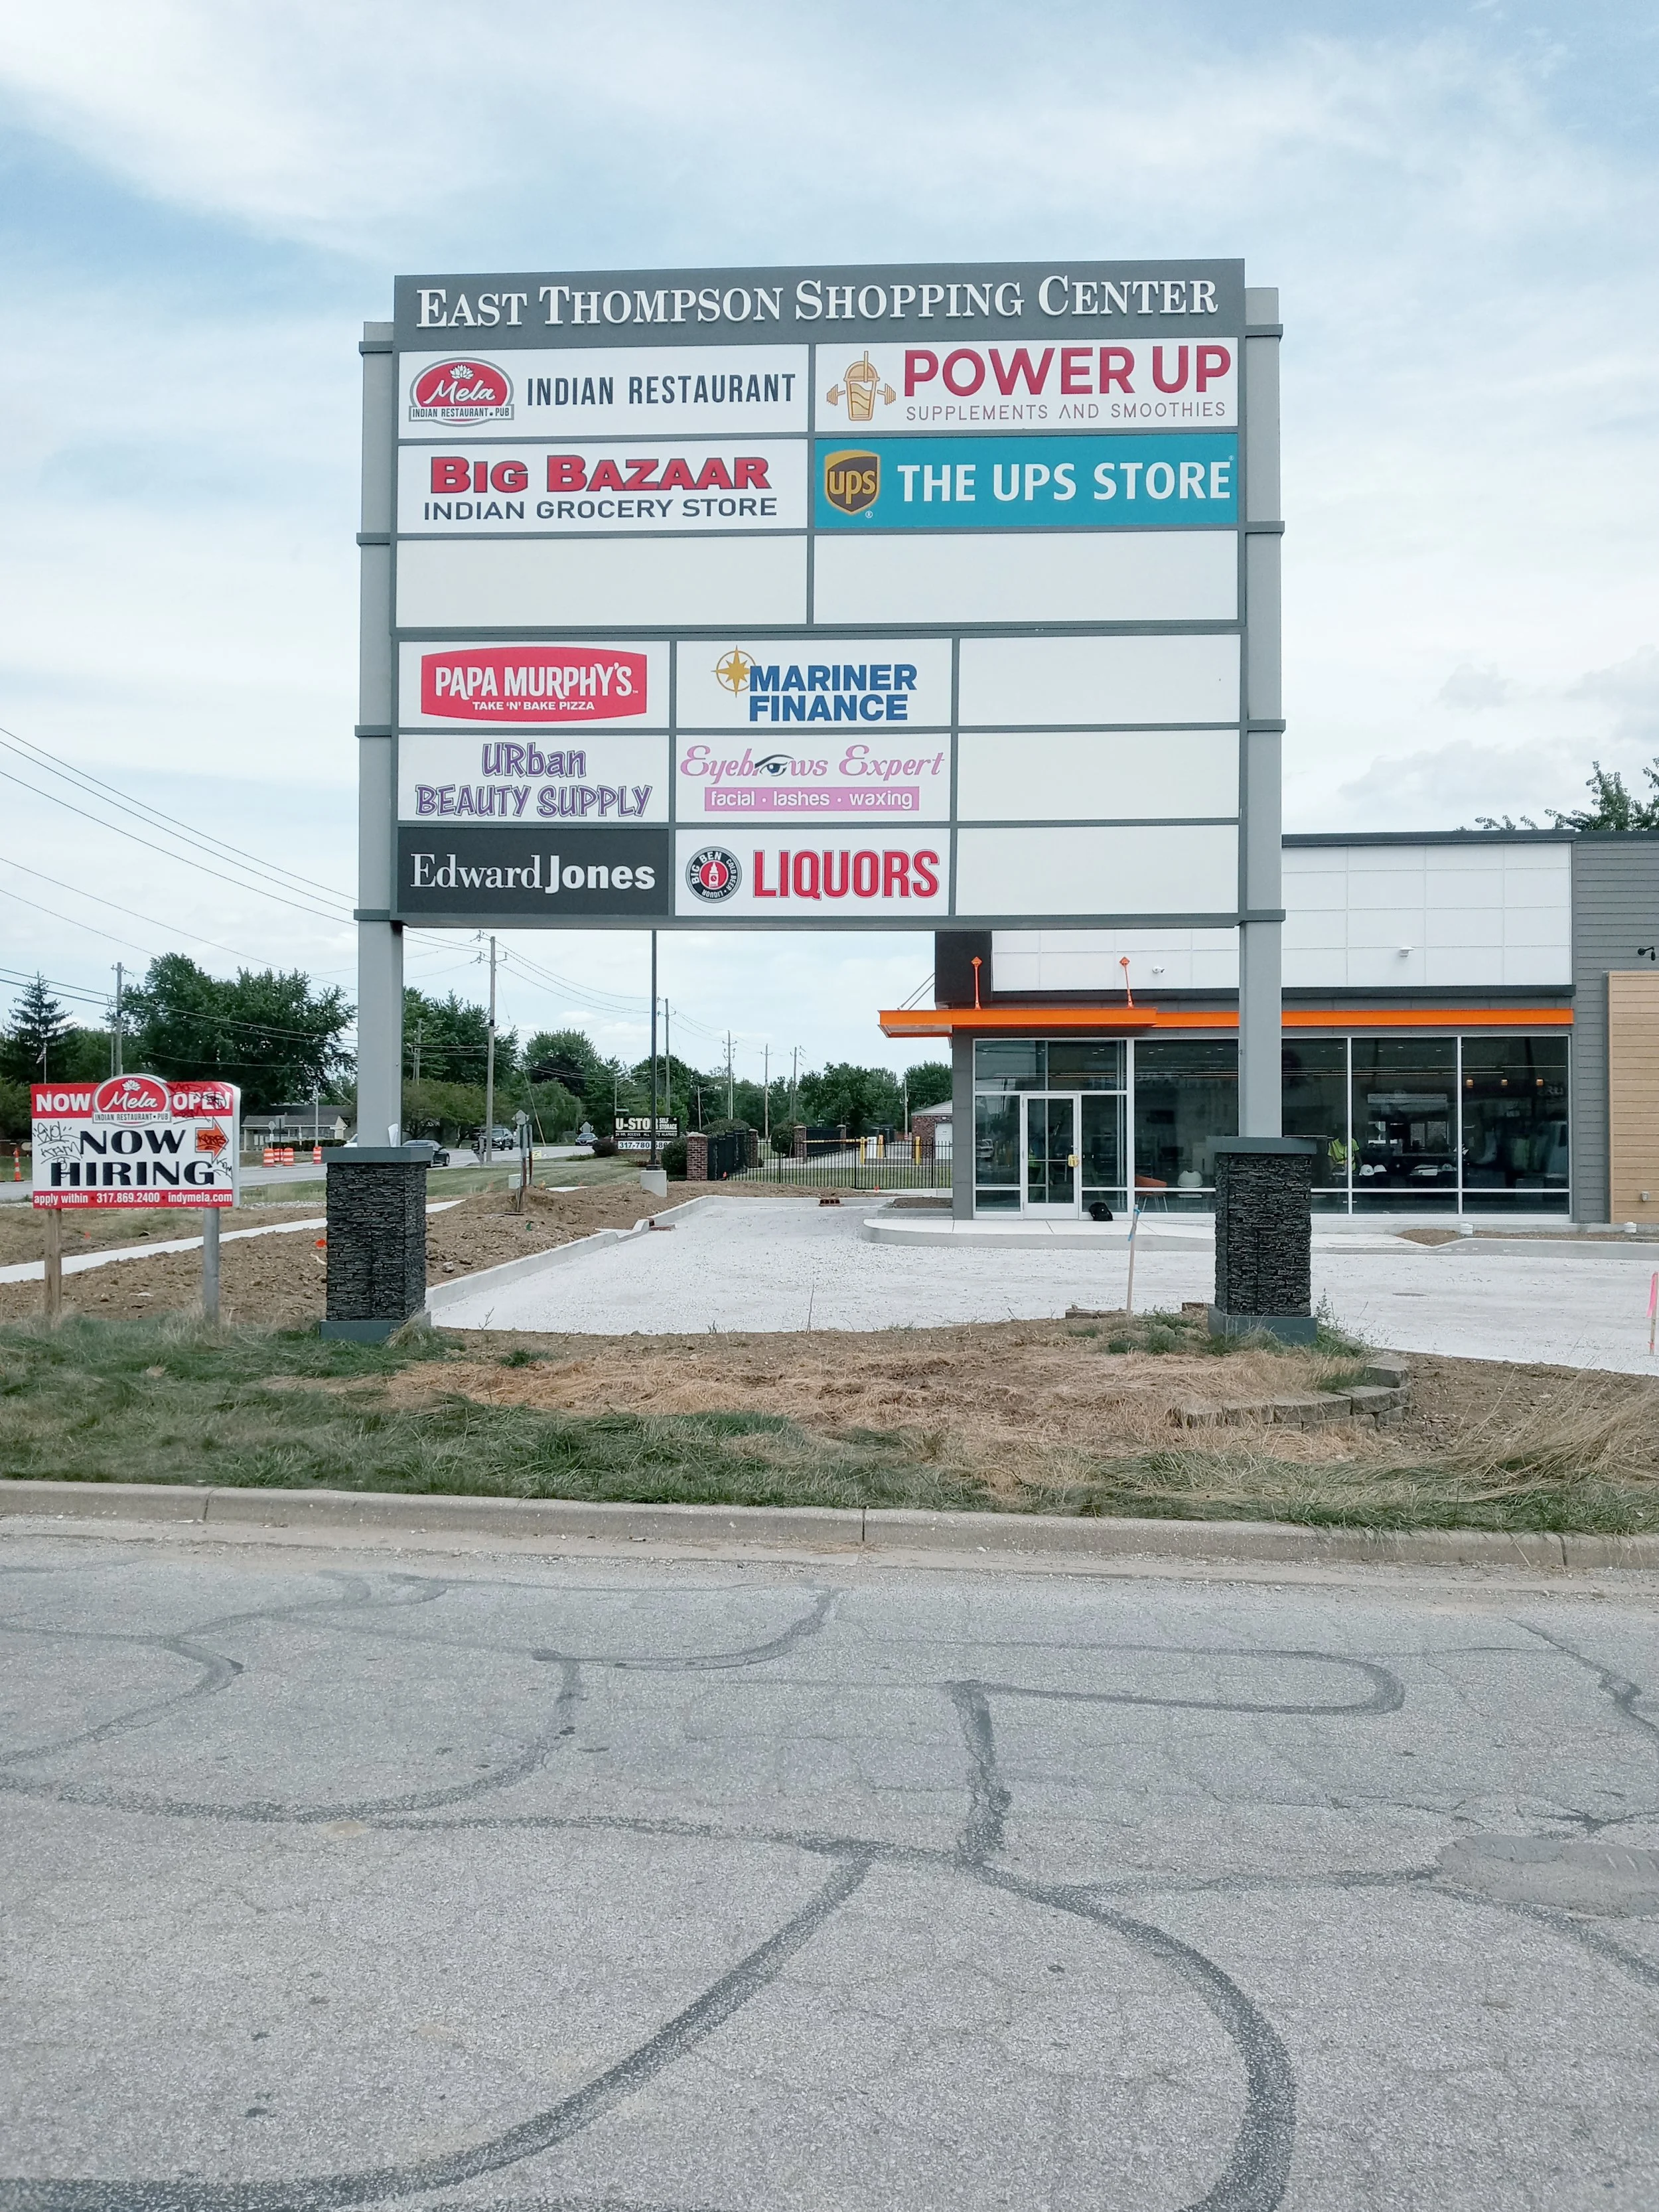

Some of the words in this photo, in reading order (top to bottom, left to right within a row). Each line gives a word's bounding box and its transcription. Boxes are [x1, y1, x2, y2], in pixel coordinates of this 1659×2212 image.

[416, 289, 528, 329] EAST
[539, 285, 783, 325] THOMPSON
[796, 279, 1024, 321] SHOPPING
[1039, 275, 1219, 317] CENTER
[904, 346, 1136, 397] POWER
[1152, 344, 1231, 394] UP
[424, 378, 496, 404] Mela
[528, 377, 614, 406] INDIAN
[628, 374, 796, 405] RESTAURANT
[412, 408, 438, 417] INDIAN
[441, 407, 488, 417] RESTAURANT
[495, 407, 510, 417] PUB
[906, 404, 1048, 421] SUPPLEMENTS
[1058, 404, 1100, 419] AND
[1111, 402, 1226, 419] SMOOTHIES
[430, 456, 528, 494] BIG
[547, 455, 772, 492] BAZAAR
[897, 465, 976, 502] THE
[993, 463, 1076, 502] UPS
[1093, 461, 1231, 500] STORE
[424, 500, 525, 520] INDIAN
[537, 498, 674, 518] GROCERY
[682, 497, 778, 517] STORE
[435, 666, 499, 700] PAPA
[504, 662, 632, 700] MURPHY'S
[749, 664, 918, 692] MARINER
[472, 701, 504, 710] TAKE
[524, 701, 556, 710] BAKE
[559, 701, 595, 710] PIZZA
[749, 694, 908, 722] FINANCE
[838, 745, 945, 780] Expert
[415, 784, 531, 817] BEAUTY
[537, 784, 653, 818] SUPPLY
[711, 790, 755, 806] facial
[773, 790, 830, 806] lashes
[849, 790, 913, 810] waxing
[691, 865, 700, 885] BIG
[699, 851, 722, 863] BEN
[726, 859, 737, 874] COLD
[753, 849, 940, 901] LIQUORS
[701, 889, 724, 899] LIQUOR
[726, 875, 737, 891] BEER
[36, 1093, 91, 1112] NOW
[173, 1091, 230, 1110] OPEN
[103, 1091, 157, 1110] Mela
[80, 1130, 186, 1155] NOW
[50, 1161, 214, 1187] HIRING
[34, 1194, 59, 1205] apply
[61, 1193, 88, 1203] within
[96, 1193, 160, 1203] 317.869.2400
[168, 1192, 232, 1205] indymela.com
